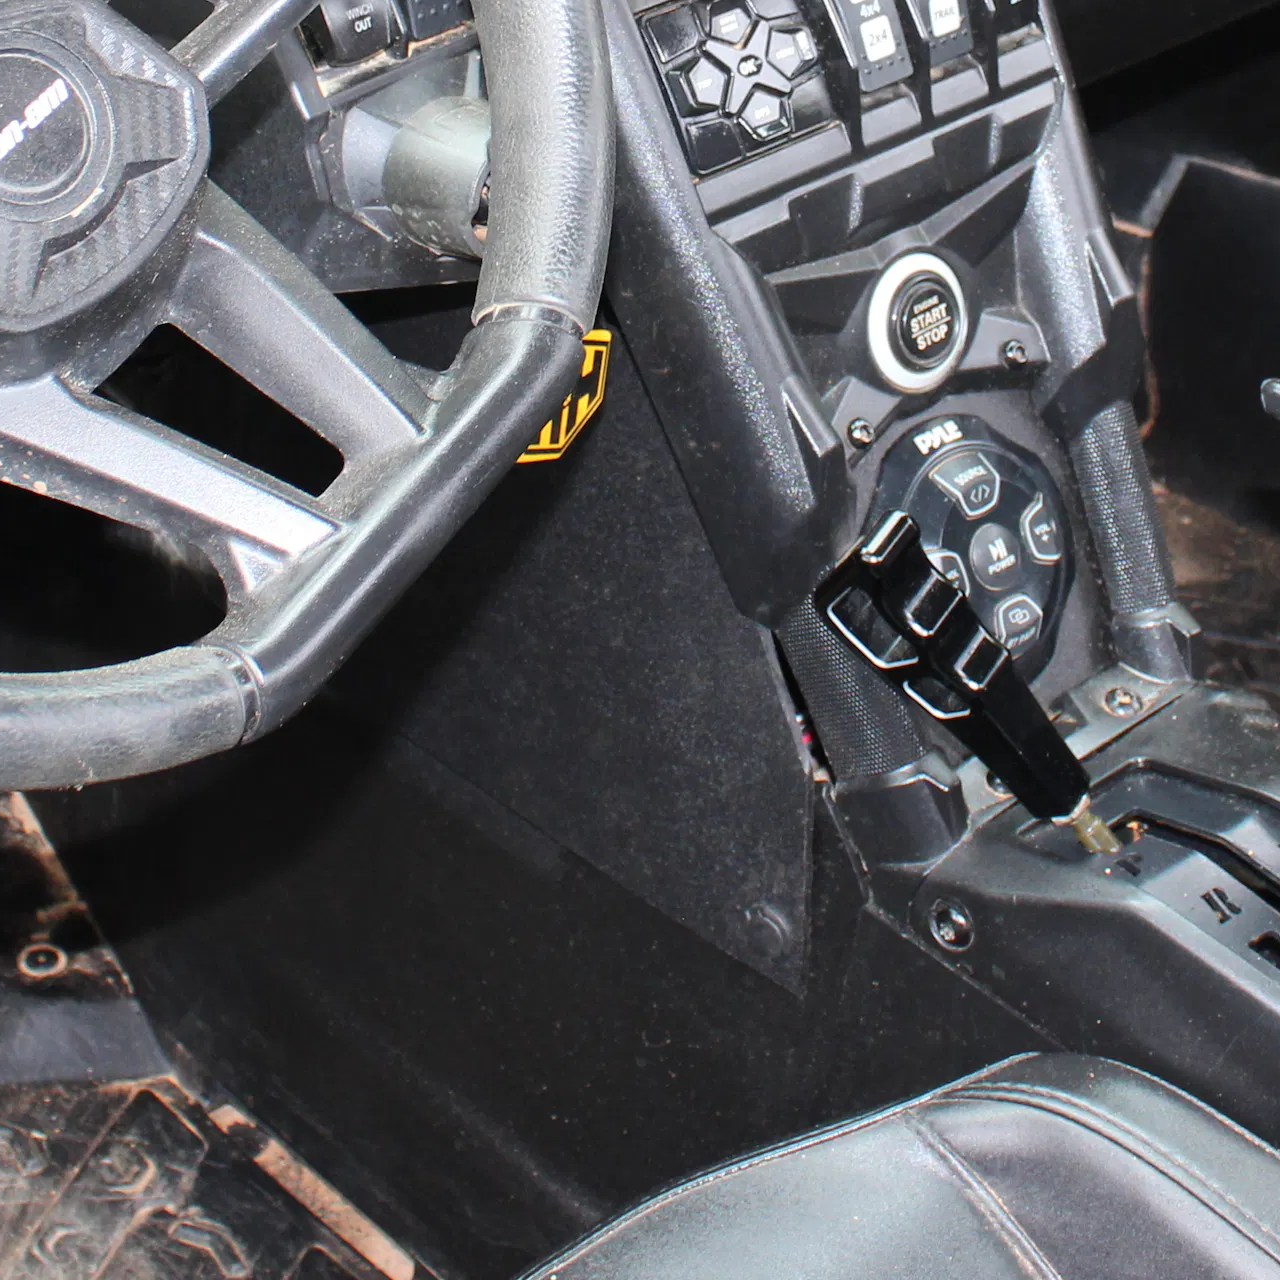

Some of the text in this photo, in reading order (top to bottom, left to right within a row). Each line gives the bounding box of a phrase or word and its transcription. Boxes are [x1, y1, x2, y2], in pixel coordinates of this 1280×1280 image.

[346, 3, 374, 21] WINCH
[860, 0, 882, 18] 4x4
[933, 5, 956, 21] TRAIL
[354, 16, 373, 33] OUT
[868, 30, 888, 47] 2x4
[910, 303, 947, 333] START
[916, 324, 948, 350] STOP
[913, 421, 963, 456] PYLE
[988, 554, 1016, 576] POWER
[1200, 887, 1243, 924] R
